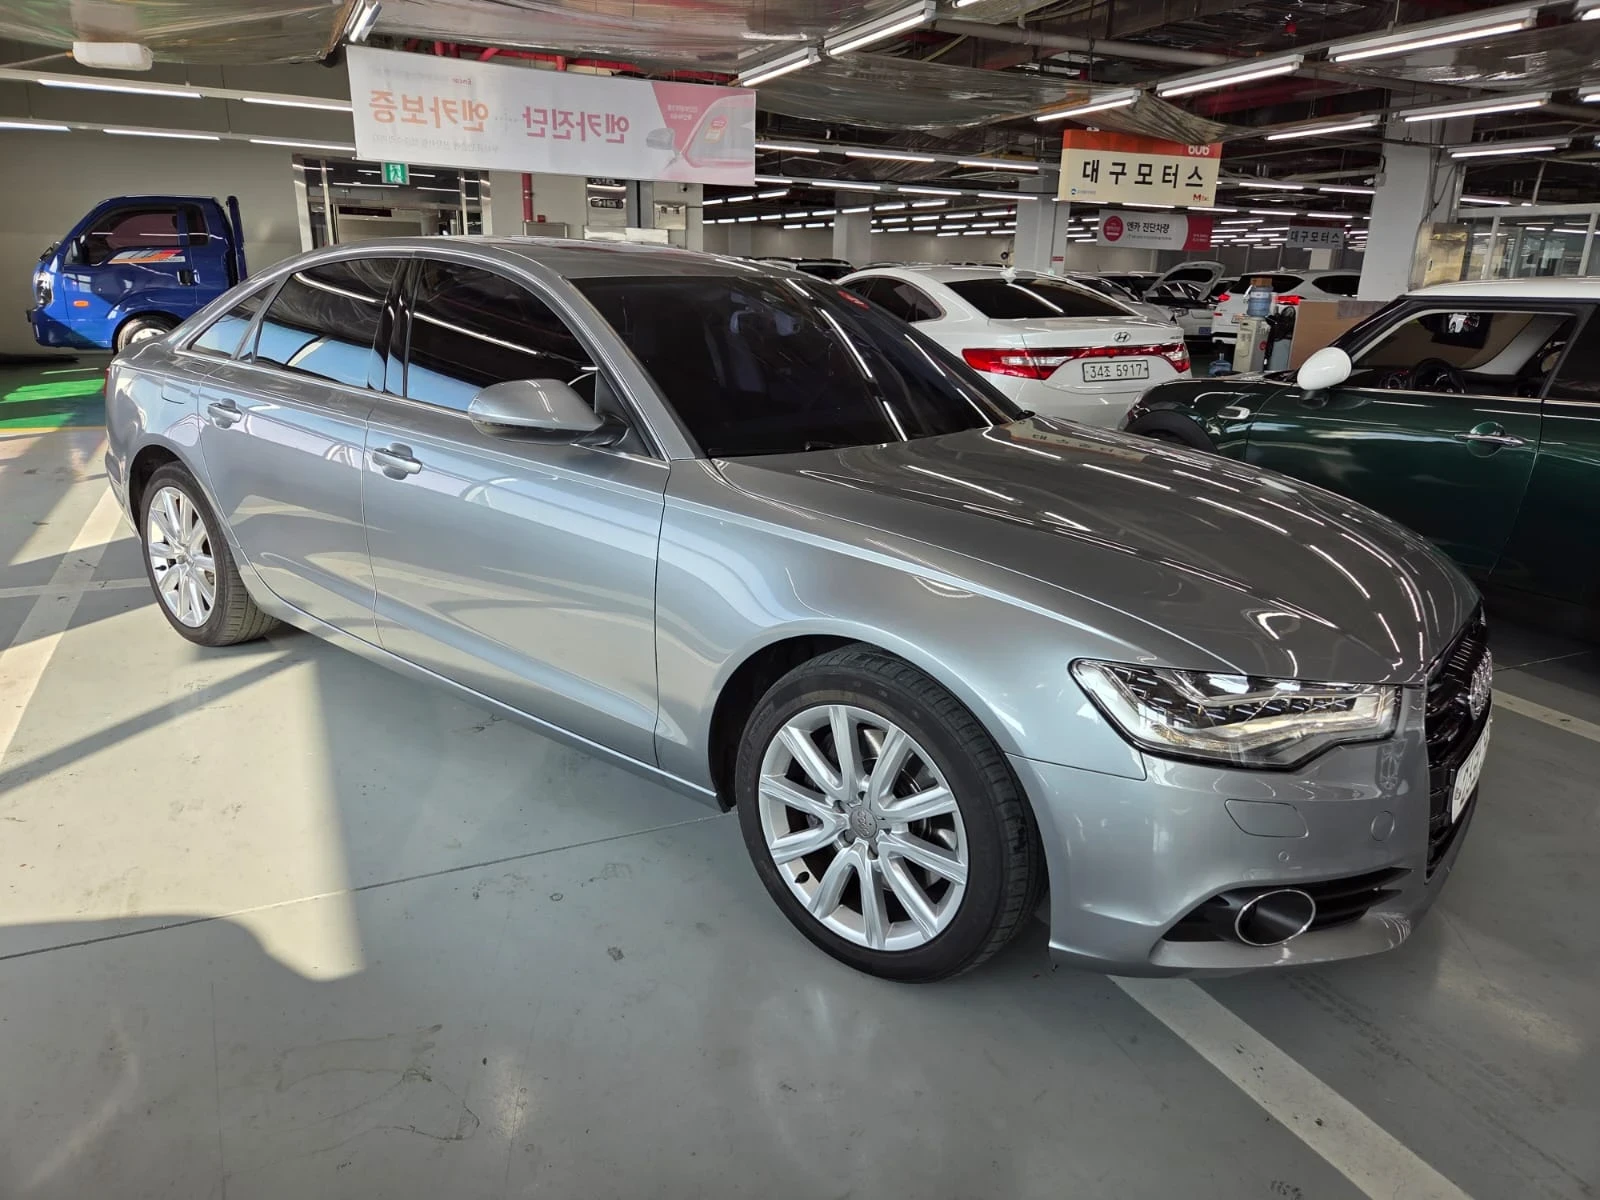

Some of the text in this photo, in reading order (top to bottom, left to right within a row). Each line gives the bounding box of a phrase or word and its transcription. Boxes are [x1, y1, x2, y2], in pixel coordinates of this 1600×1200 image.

[1126, 221, 1140, 233] 엔카
[1142, 222, 1170, 234] 진단차량
[1290, 230, 1340, 244] 대구모터스
[1090, 363, 1142, 379] 34조 5917
